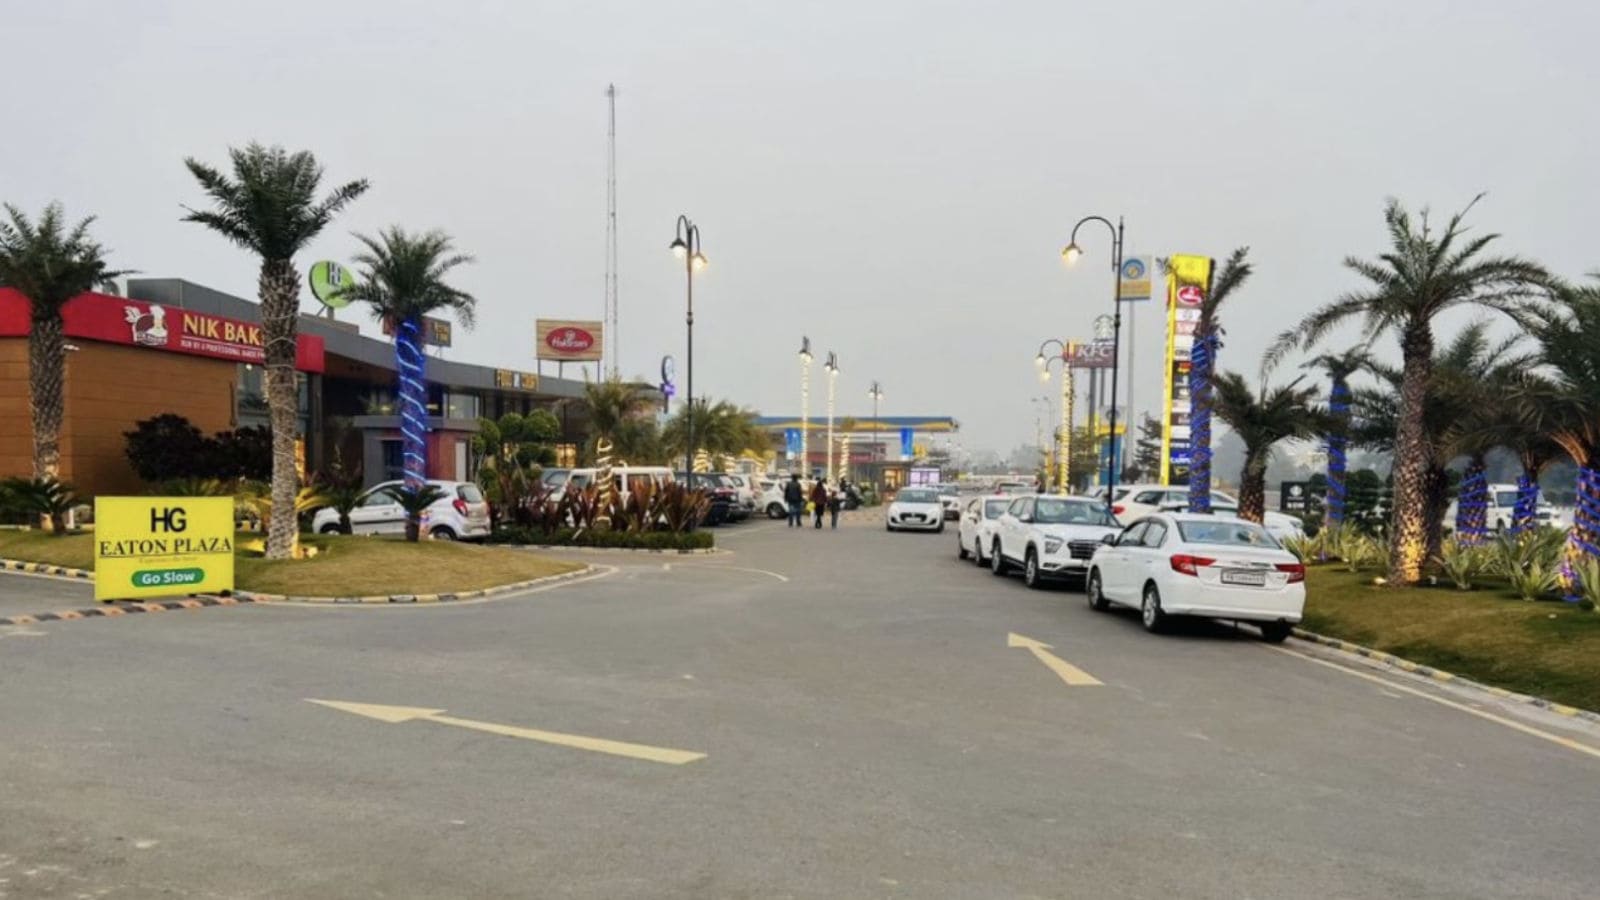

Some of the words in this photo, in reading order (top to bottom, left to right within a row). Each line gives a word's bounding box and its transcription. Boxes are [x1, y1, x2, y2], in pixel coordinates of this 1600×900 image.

[183, 313, 220, 339] NIK
[224, 321, 265, 346] BAK
[1077, 345, 1111, 358] KFC
[151, 507, 187, 533] HG
[99, 539, 168, 556] EATON
[174, 537, 232, 553] PLAZA
[142, 573, 161, 585] Go
[163, 571, 196, 584] Slow
